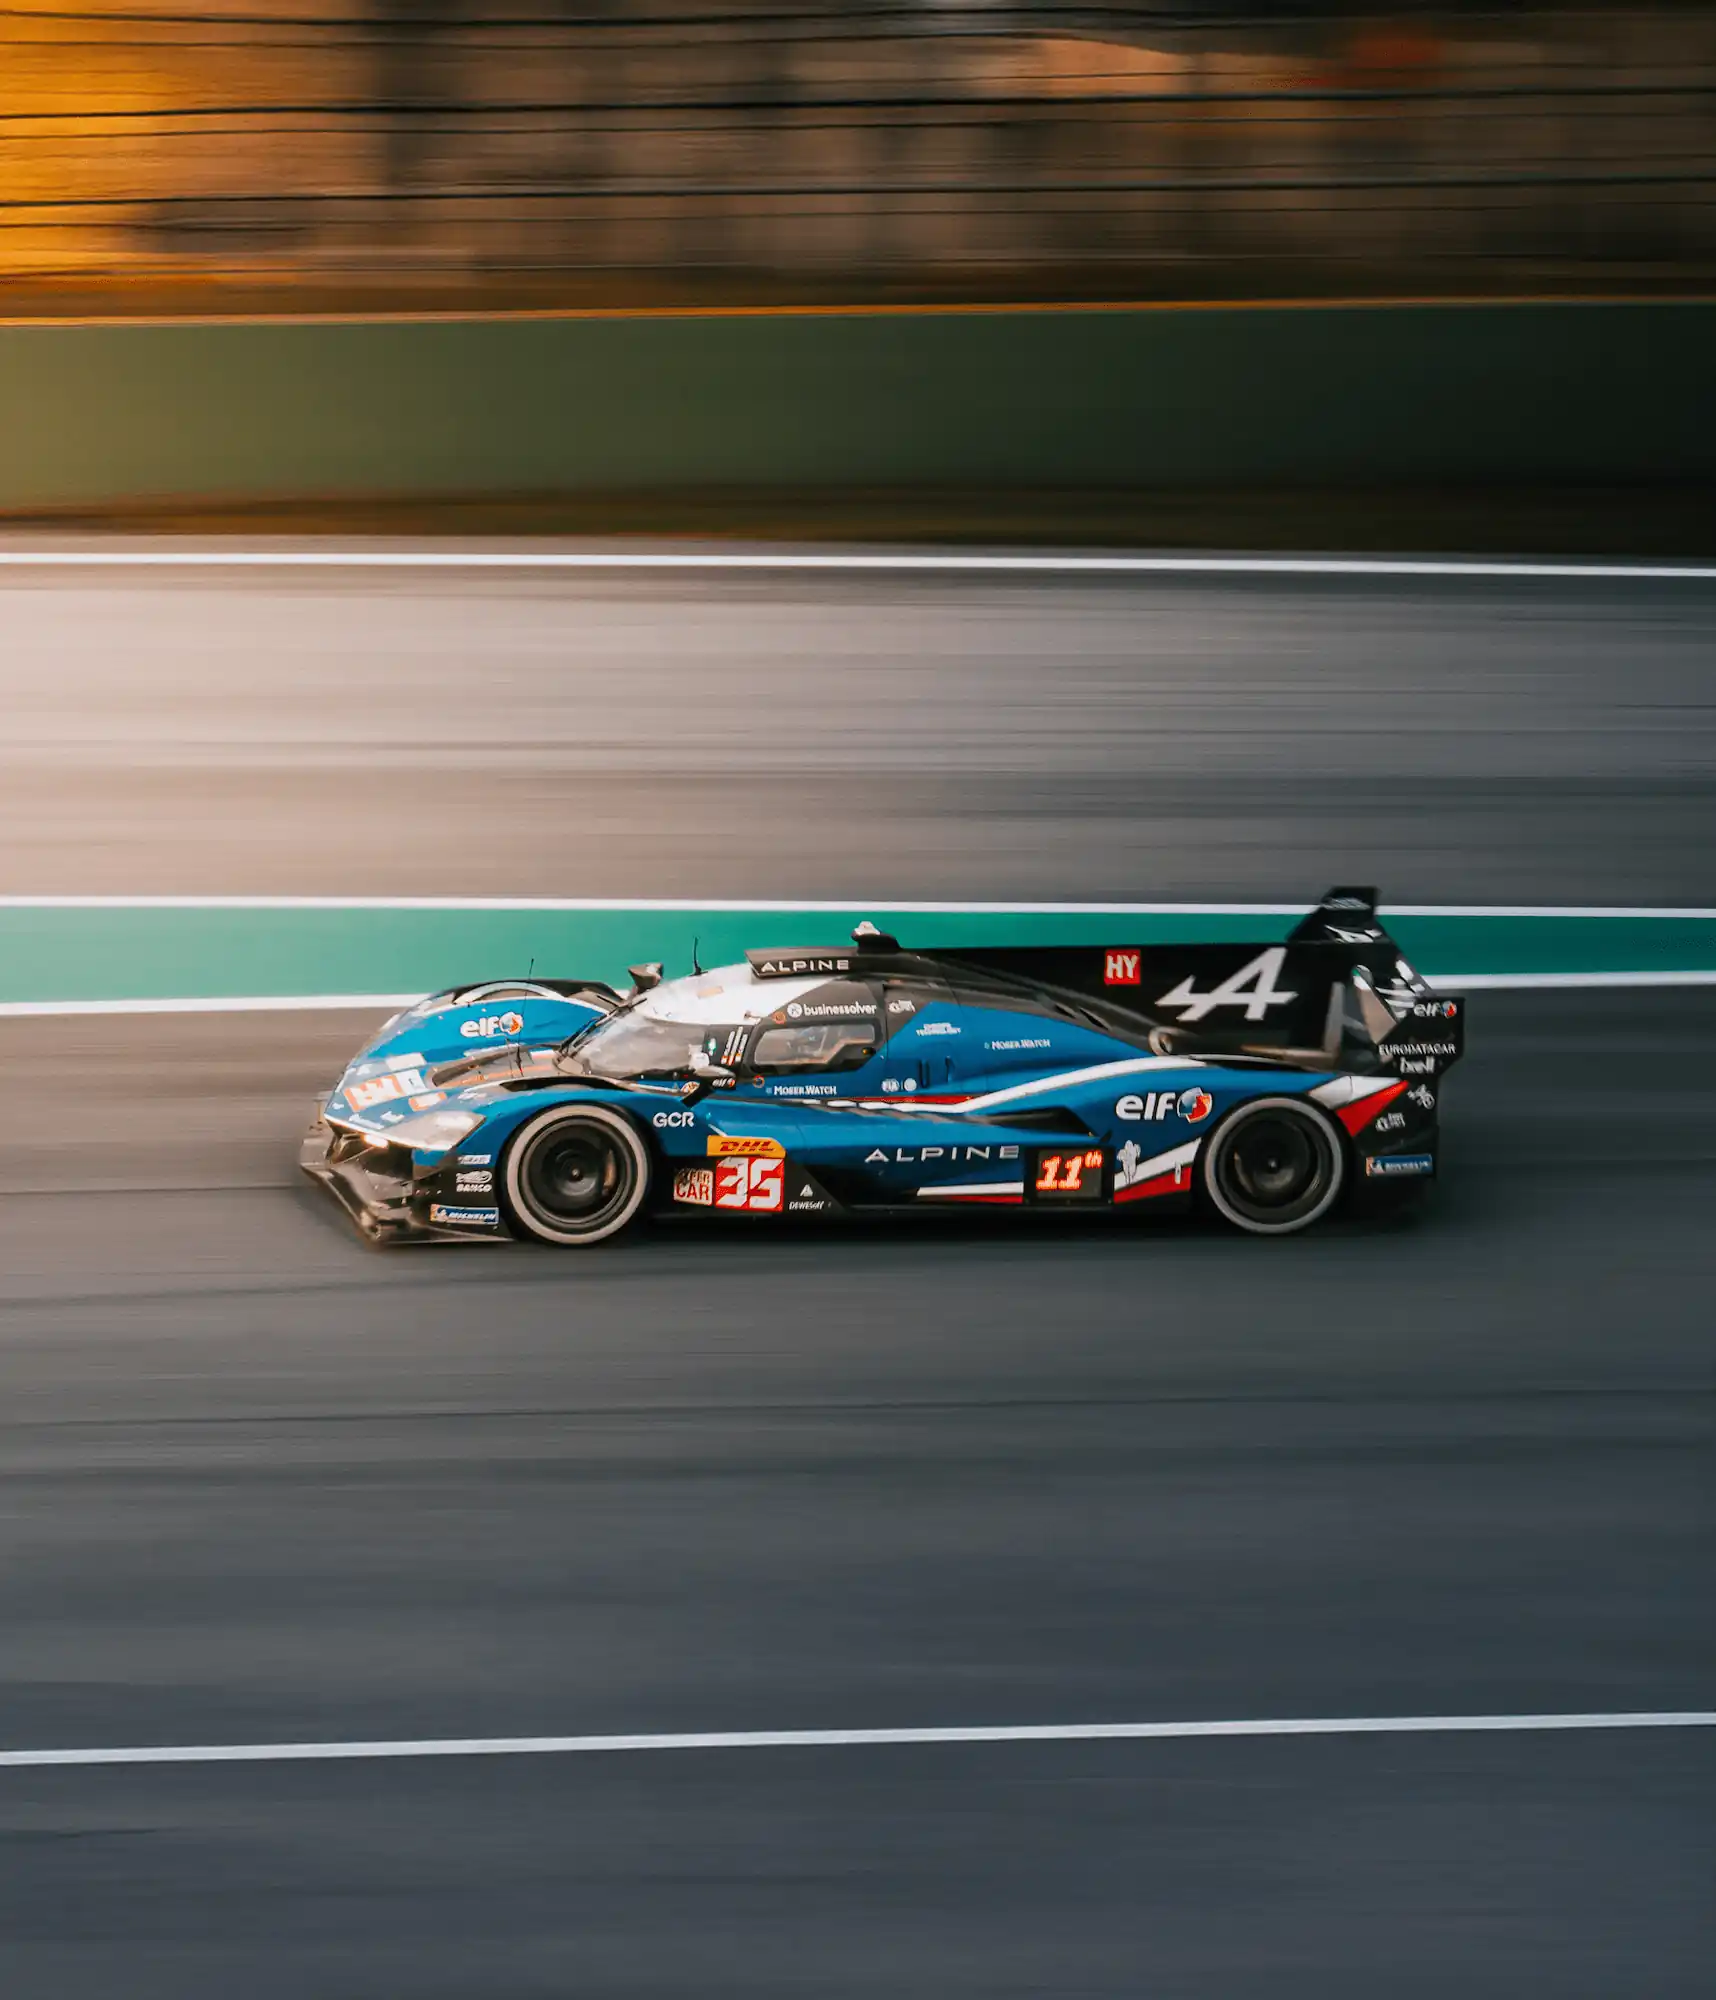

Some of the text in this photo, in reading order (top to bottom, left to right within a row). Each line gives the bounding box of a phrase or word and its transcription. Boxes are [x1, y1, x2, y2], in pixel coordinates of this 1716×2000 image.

[761, 960, 849, 973] ALPINE
[1106, 954, 1138, 979] HY
[804, 1001, 877, 1017] businessolver
[1414, 1002, 1441, 1017] elf
[460, 1016, 501, 1038] elf
[1115, 1094, 1176, 1121] elf
[652, 1111, 695, 1128] GCR
[719, 1140, 774, 1152] DHL
[864, 1145, 1020, 1163] ALPINE
[715, 1156, 783, 1209] 35
[676, 1183, 710, 1200] CAR
